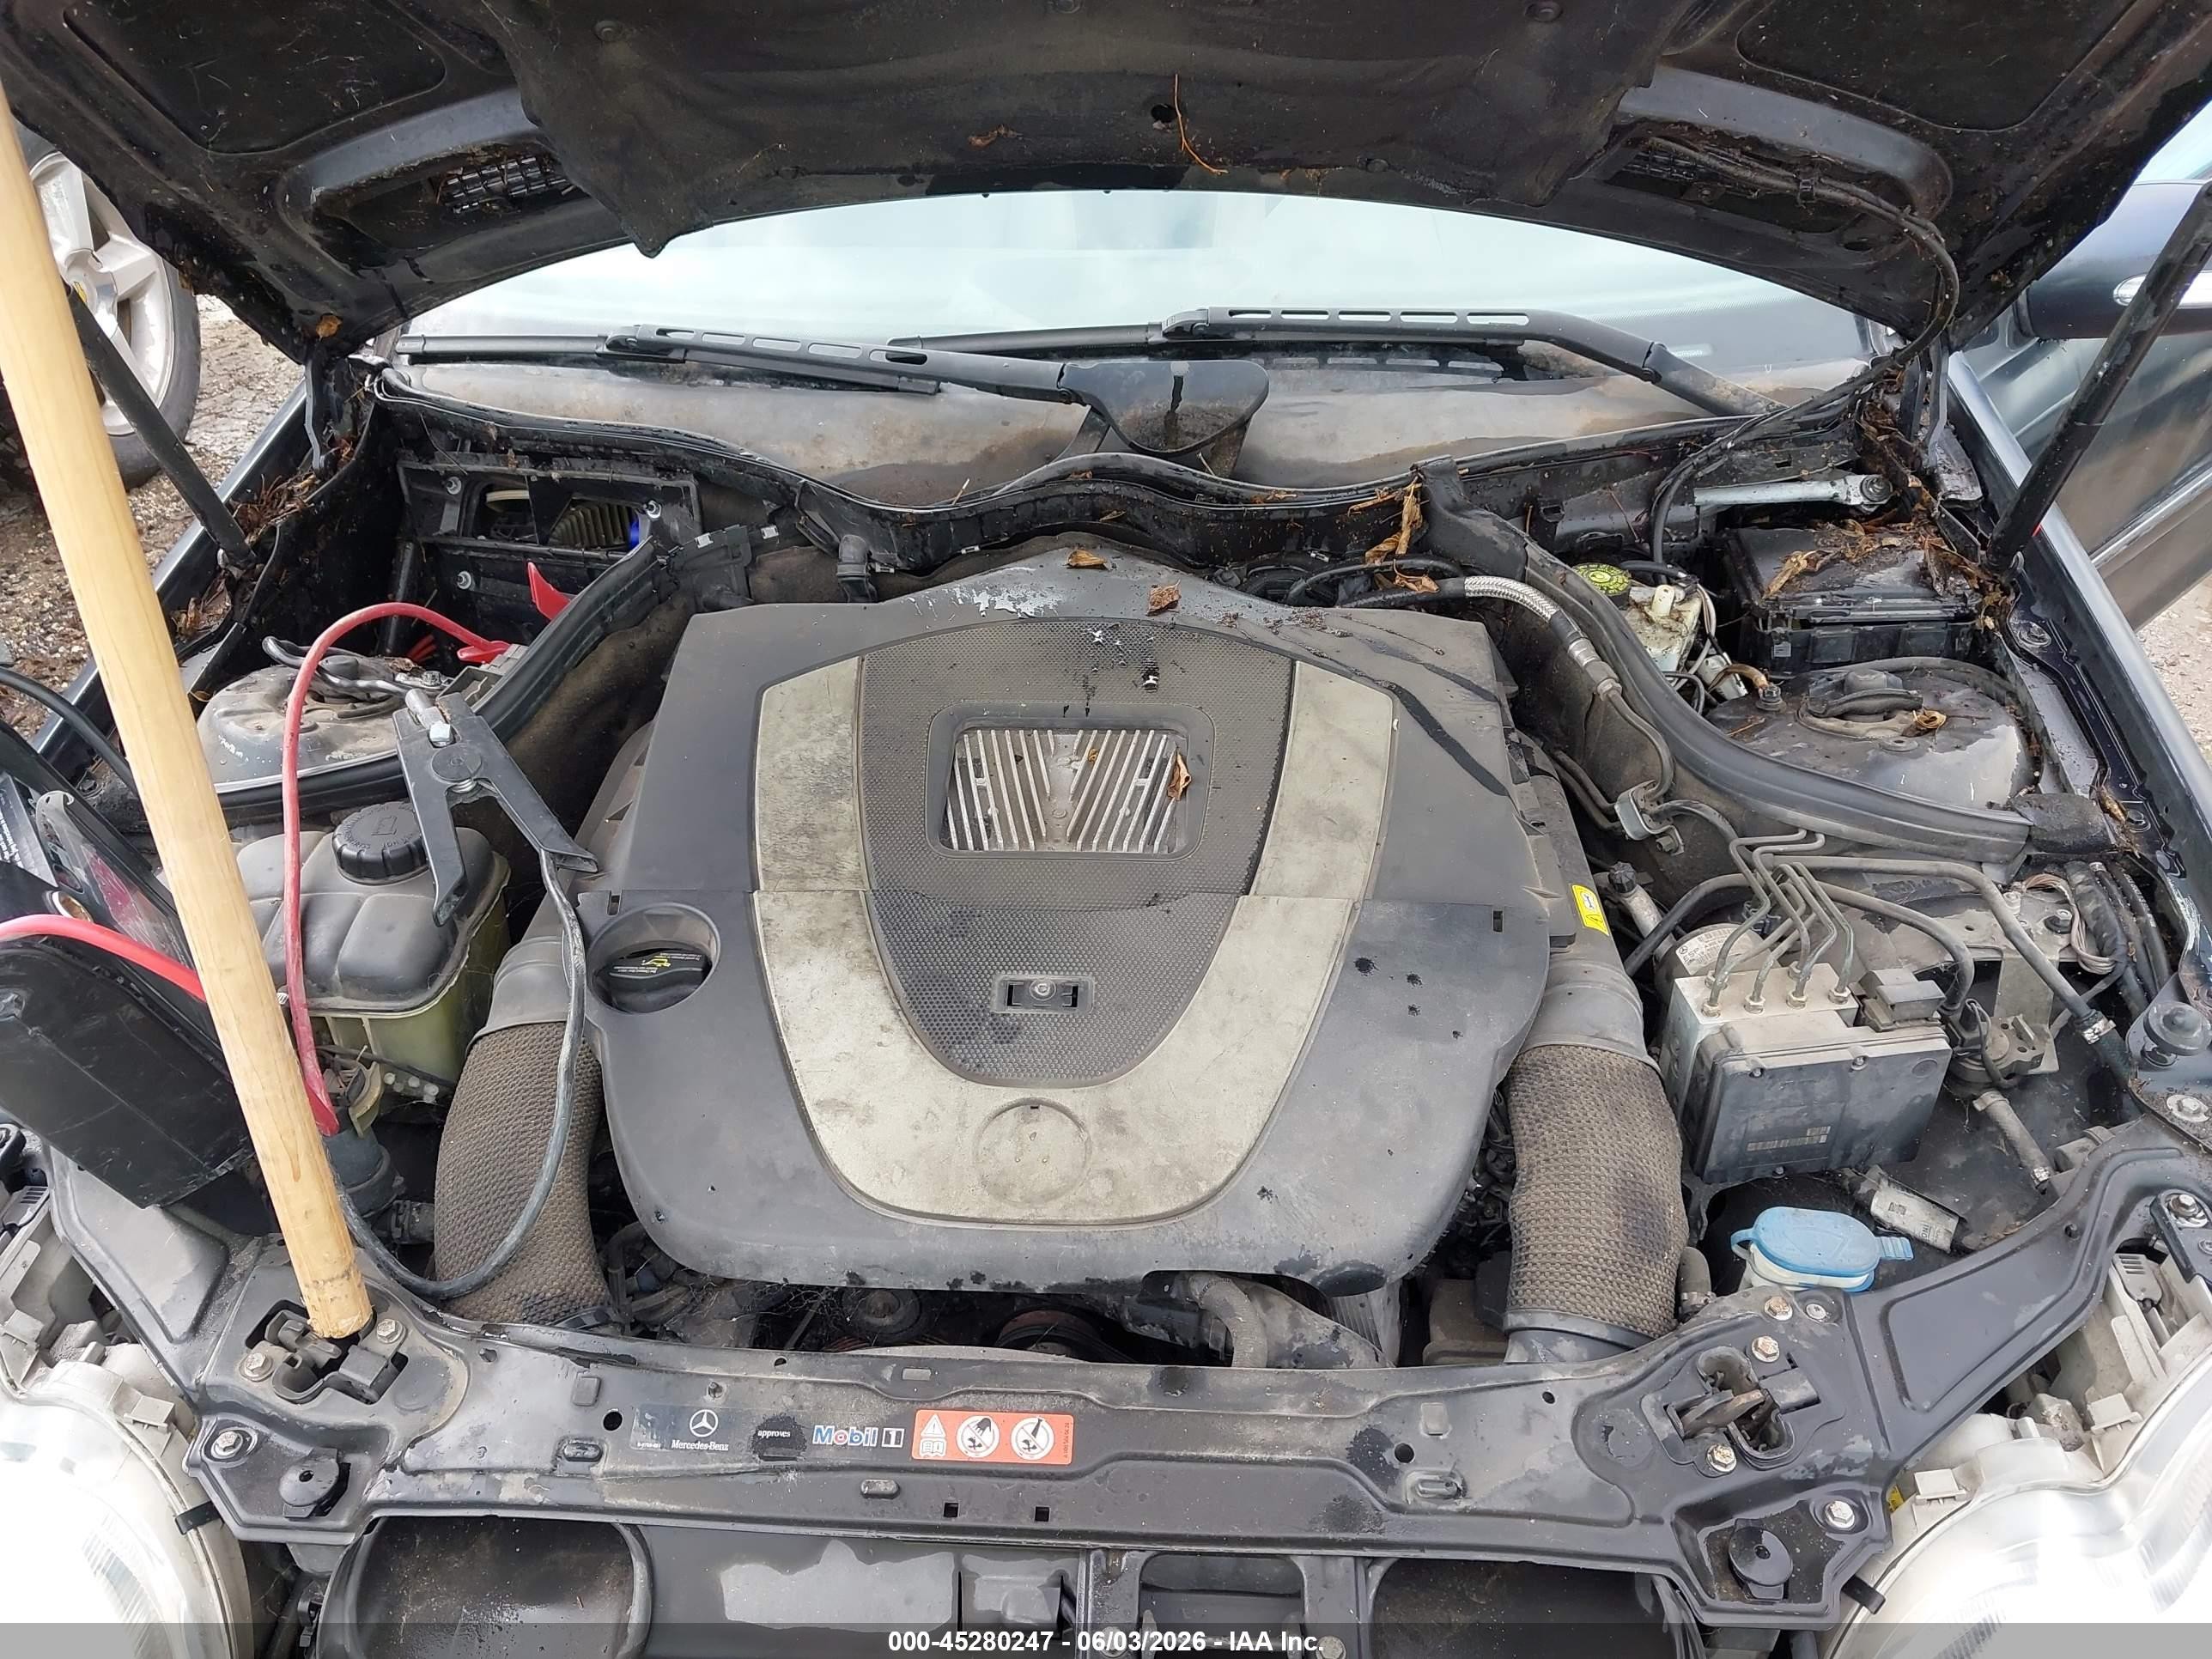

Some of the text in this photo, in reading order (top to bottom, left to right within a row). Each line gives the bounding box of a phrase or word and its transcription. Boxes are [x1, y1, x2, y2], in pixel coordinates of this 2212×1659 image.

[757, 1430, 791, 1439] approves
[812, 1425, 879, 1447] Mobil
[672, 1439, 729, 1451] Mercedes-Benz
